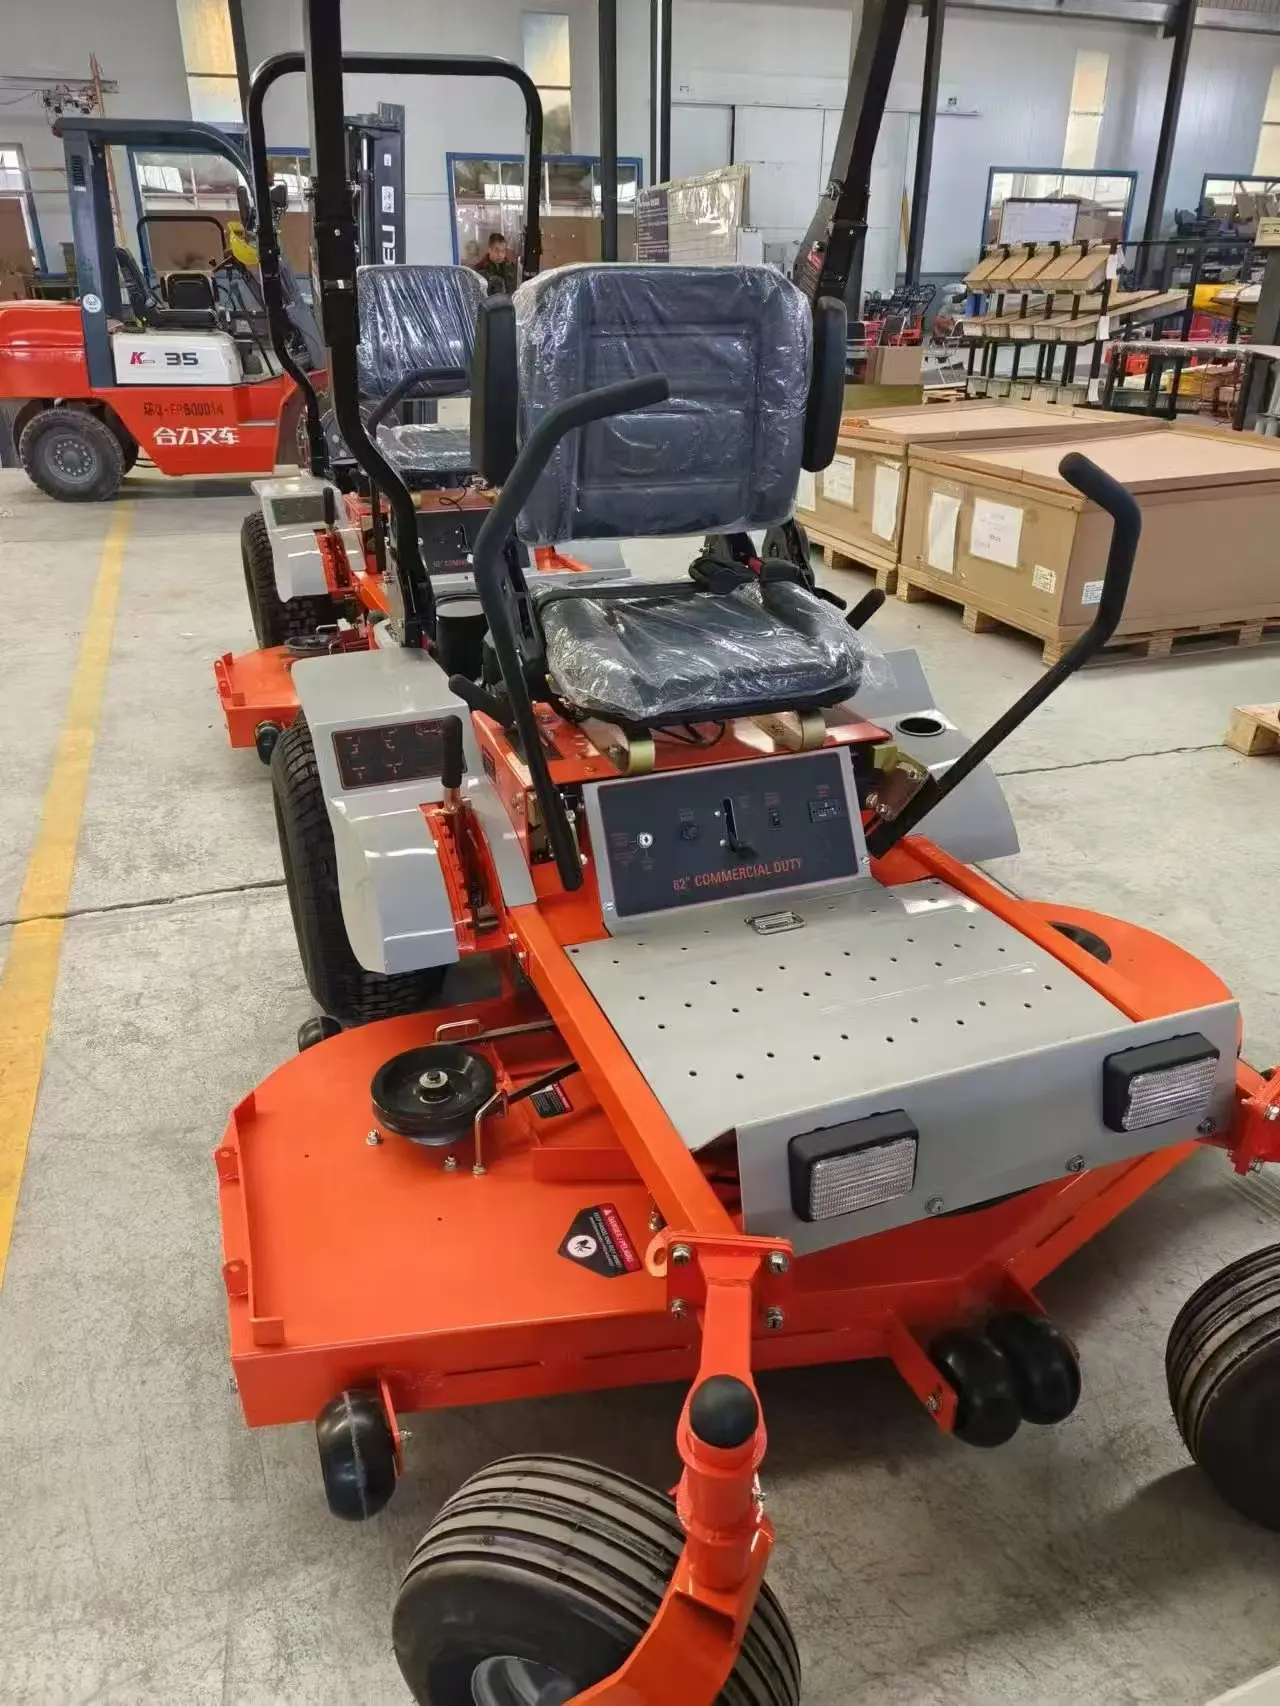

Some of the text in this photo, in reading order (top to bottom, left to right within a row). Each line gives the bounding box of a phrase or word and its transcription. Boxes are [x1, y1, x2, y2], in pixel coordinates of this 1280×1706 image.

[164, 352, 199, 366] 35
[153, 426, 240, 446] 合力叉车
[694, 864, 773, 887] COMMERCIAL
[773, 858, 803, 874] DUTY
[607, 1215, 623, 1240] DANGER
